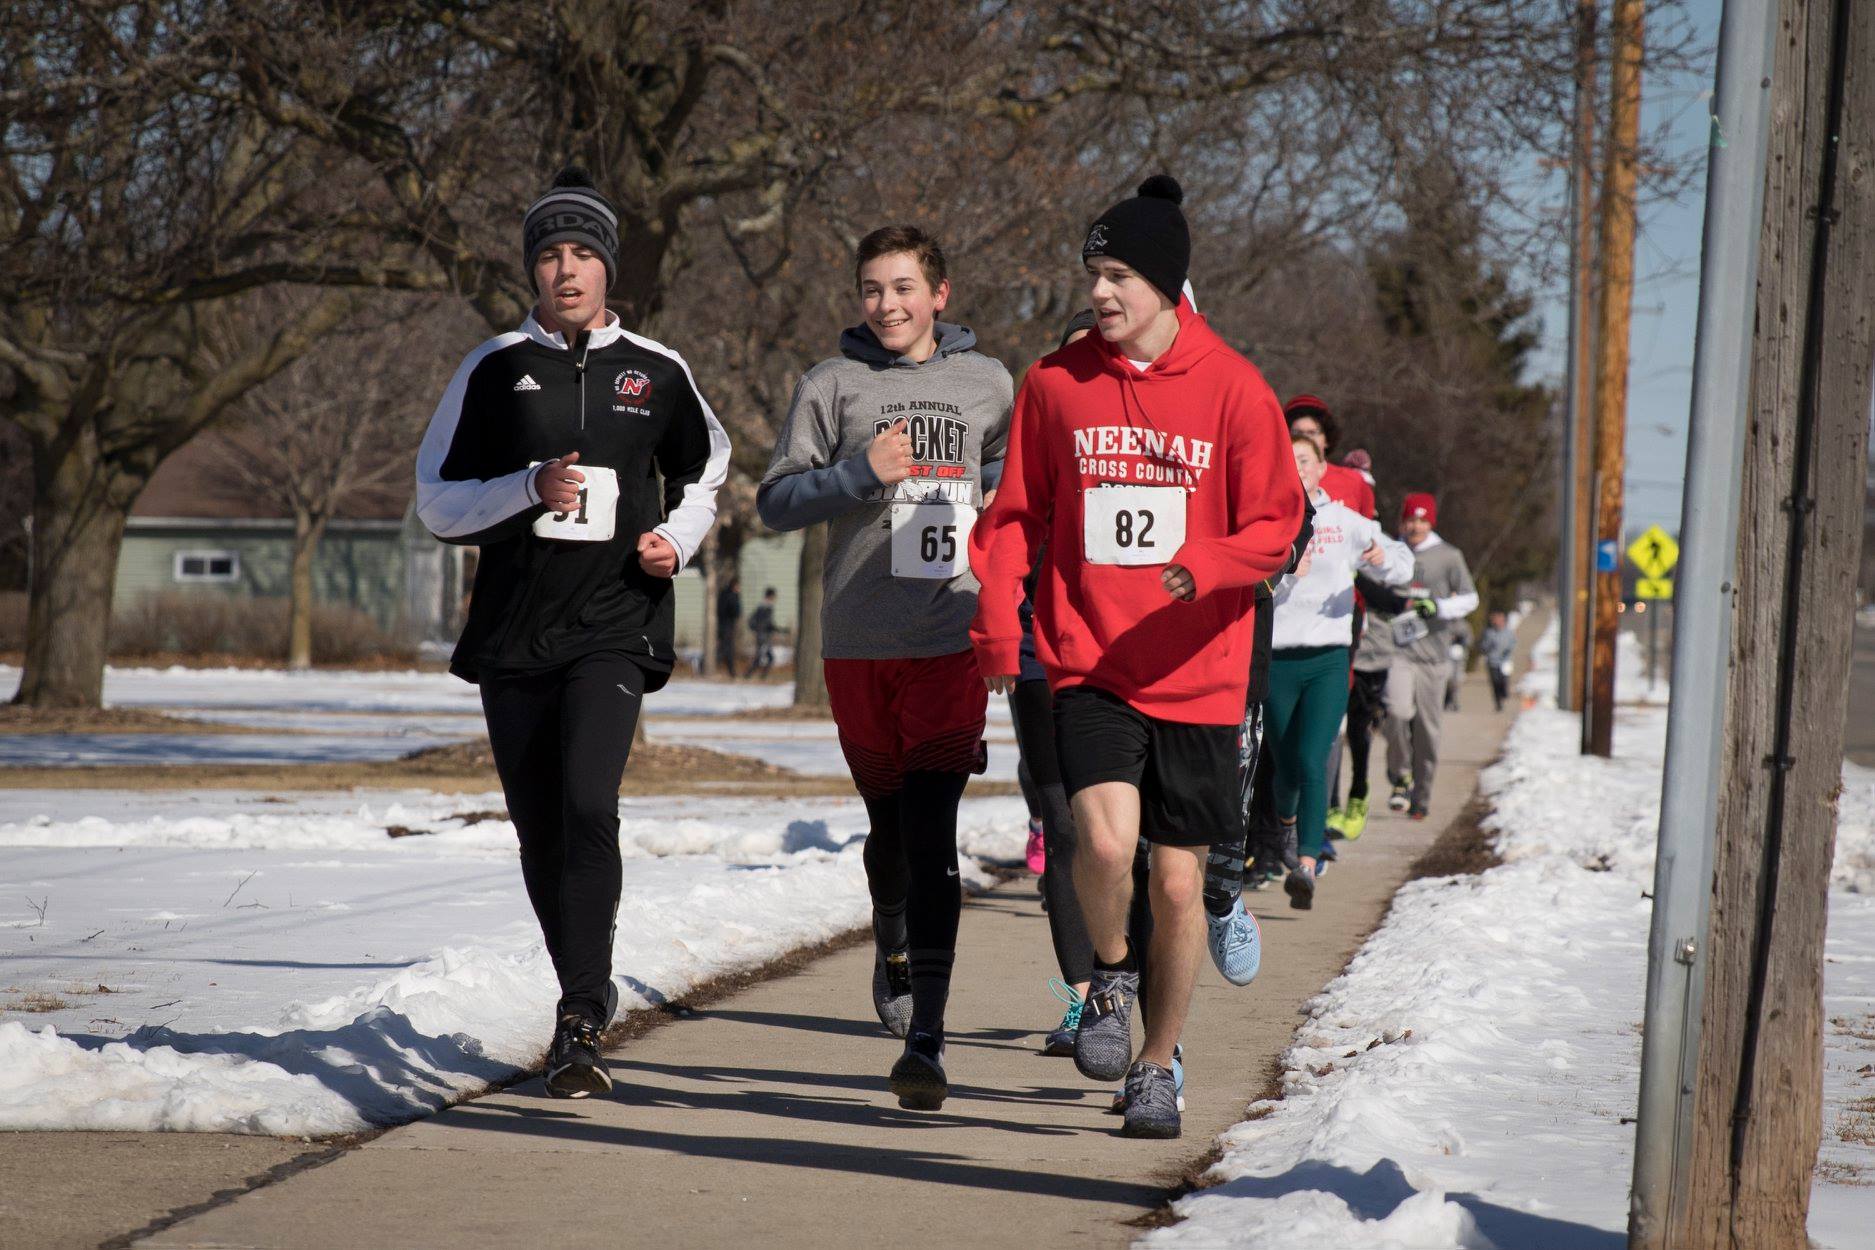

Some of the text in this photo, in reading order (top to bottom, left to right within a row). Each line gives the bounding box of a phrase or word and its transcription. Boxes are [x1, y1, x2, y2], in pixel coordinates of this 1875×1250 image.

[880, 401, 962, 416] 12th ANNUAL
[1073, 426, 1214, 469] NEENAH
[936, 465, 967, 478] OFF
[1079, 457, 1128, 478] CROSS
[1115, 509, 1156, 549] 82
[920, 525, 957, 563] 65
